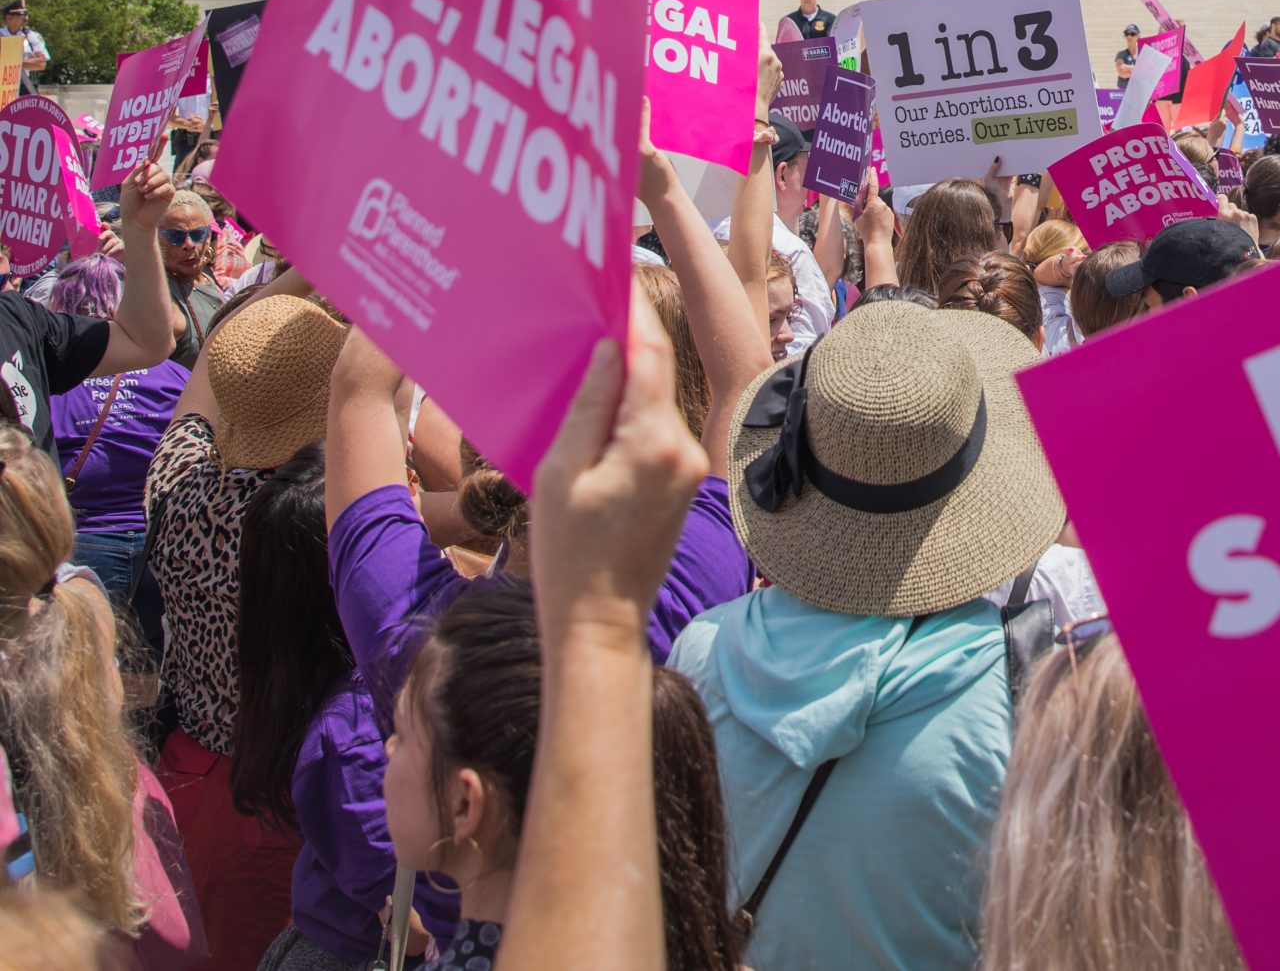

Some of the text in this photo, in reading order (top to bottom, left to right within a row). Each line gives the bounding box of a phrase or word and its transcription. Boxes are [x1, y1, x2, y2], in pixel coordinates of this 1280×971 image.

[887, 10, 1058, 88] 1 in 3
[10, 98, 38, 115] FEMINIST
[39, 99, 67, 126] MAJORITY
[894, 106, 929, 123] Our
[934, 94, 1034, 119] Abortions.
[1037, 88, 1075, 106] Our
[816, 130, 862, 162] Human
[900, 115, 1073, 148] Stories. Our Lives.
[11, 181, 48, 215] WAR
[1081, 163, 1157, 210] SAFE,
